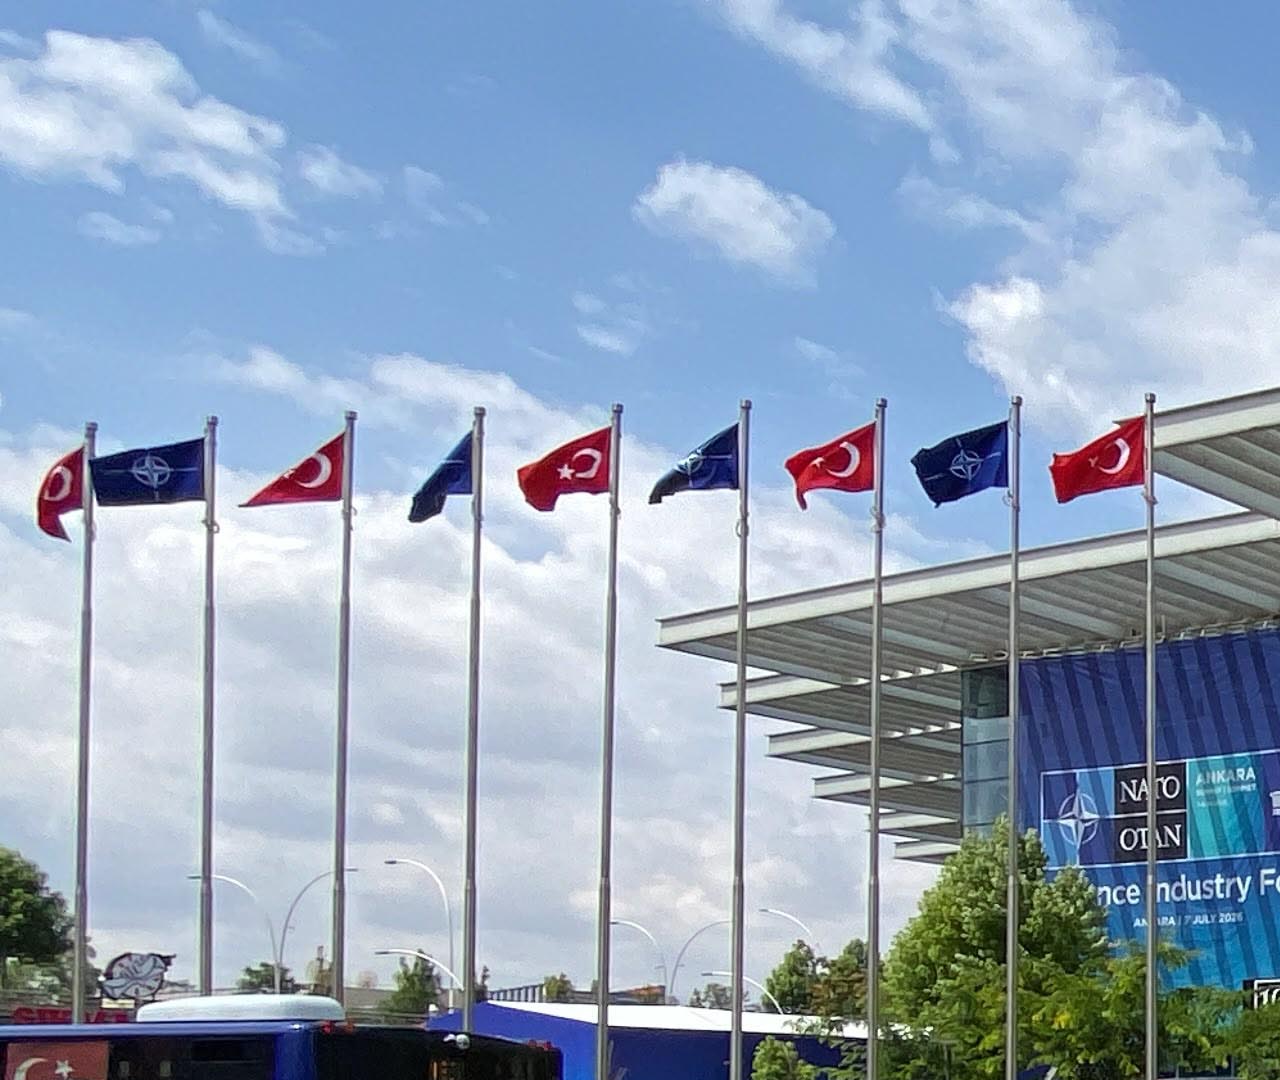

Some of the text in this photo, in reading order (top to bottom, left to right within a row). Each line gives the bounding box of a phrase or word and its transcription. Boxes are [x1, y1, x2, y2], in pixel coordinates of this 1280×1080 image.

[1196, 767, 1256, 786] ANKARA
[1120, 776, 1180, 803] NATO
[1156, 873, 1251, 903] ndustry
[1133, 915, 1176, 928] ANRA
[1192, 914, 1217, 925] JULY
